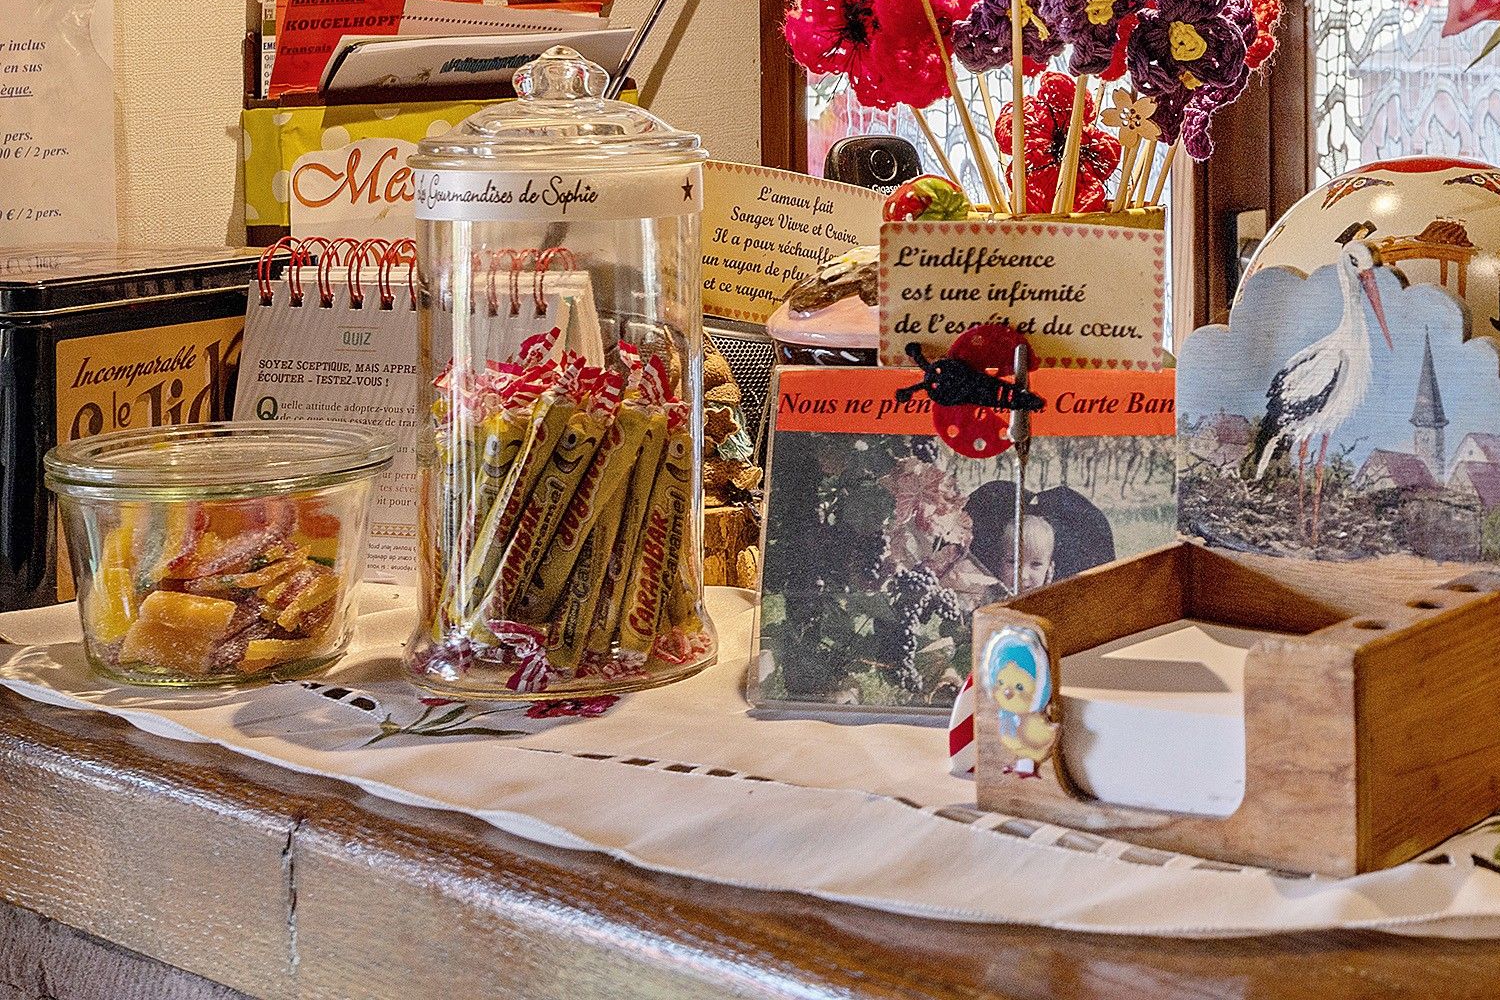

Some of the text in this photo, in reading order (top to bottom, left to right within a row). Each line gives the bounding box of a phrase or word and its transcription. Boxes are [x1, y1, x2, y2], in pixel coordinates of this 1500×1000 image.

[8, 39, 46, 52] inclus
[4, 63, 19, 74] en
[22, 63, 43, 73] sus
[4, 131, 33, 145] pers.
[33, 146, 41, 157] 2
[42, 147, 69, 160] pers.
[427, 174, 513, 209] Gourmandises
[518, 180, 541, 204] de
[542, 175, 599, 215] Sophie
[757, 185, 834, 216] L'amour fait
[25, 208, 32, 219] 2
[35, 206, 62, 221] pers.
[730, 206, 860, 246] Songer Vivre et Croire.
[712, 227, 840, 266] Il a pour réchauffe
[701, 255, 720, 266] un
[722, 257, 763, 275] rayon
[764, 261, 781, 276] de
[894, 245, 1056, 275] L'indifférence
[703, 277, 716, 290] et
[718, 281, 733, 293] ce
[901, 280, 1088, 307] est une infirmité
[894, 313, 921, 335] de
[1017, 317, 1038, 335] et
[1043, 314, 1075, 336] du
[1080, 322, 1143, 339] cœur.
[342, 331, 372, 346] QUIZ
[70, 344, 197, 388] Incomparable
[258, 359, 293, 370] SOYEZ
[296, 360, 352, 373] SCEPTIQUE,
[354, 363, 380, 374] MAIS
[257, 370, 304, 384] ÉCOUTER
[315, 374, 382, 387] TESTEZ-VOUS
[112, 390, 131, 429] le
[305, 401, 342, 411] attitude
[344, 402, 404, 415] adoptez-vous
[779, 391, 841, 415] Nous
[844, 399, 873, 415] ne
[1054, 391, 1120, 415] Carte
[384, 416, 396, 427] de
[388, 498, 412, 508] pour
[629, 489, 686, 636] CARAMBAR Caramel
